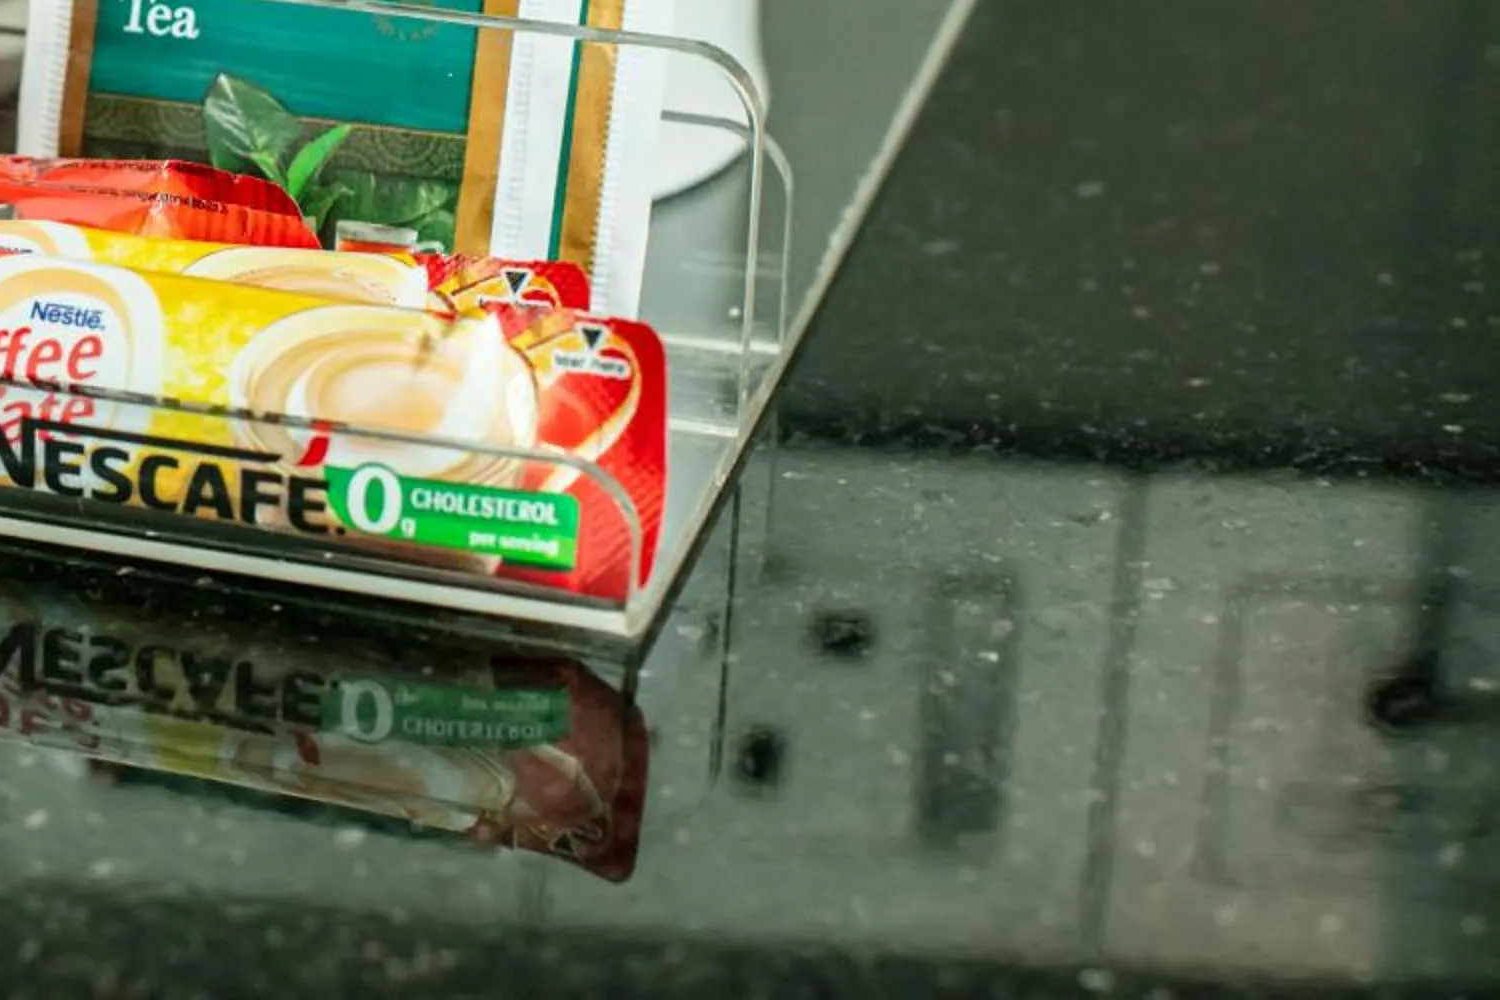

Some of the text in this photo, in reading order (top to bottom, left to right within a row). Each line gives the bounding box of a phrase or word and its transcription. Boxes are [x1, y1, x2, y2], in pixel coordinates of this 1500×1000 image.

[346, 463, 402, 534] 0
[410, 487, 559, 526] CHOLESTEROL
[467, 530, 560, 556] per serving
